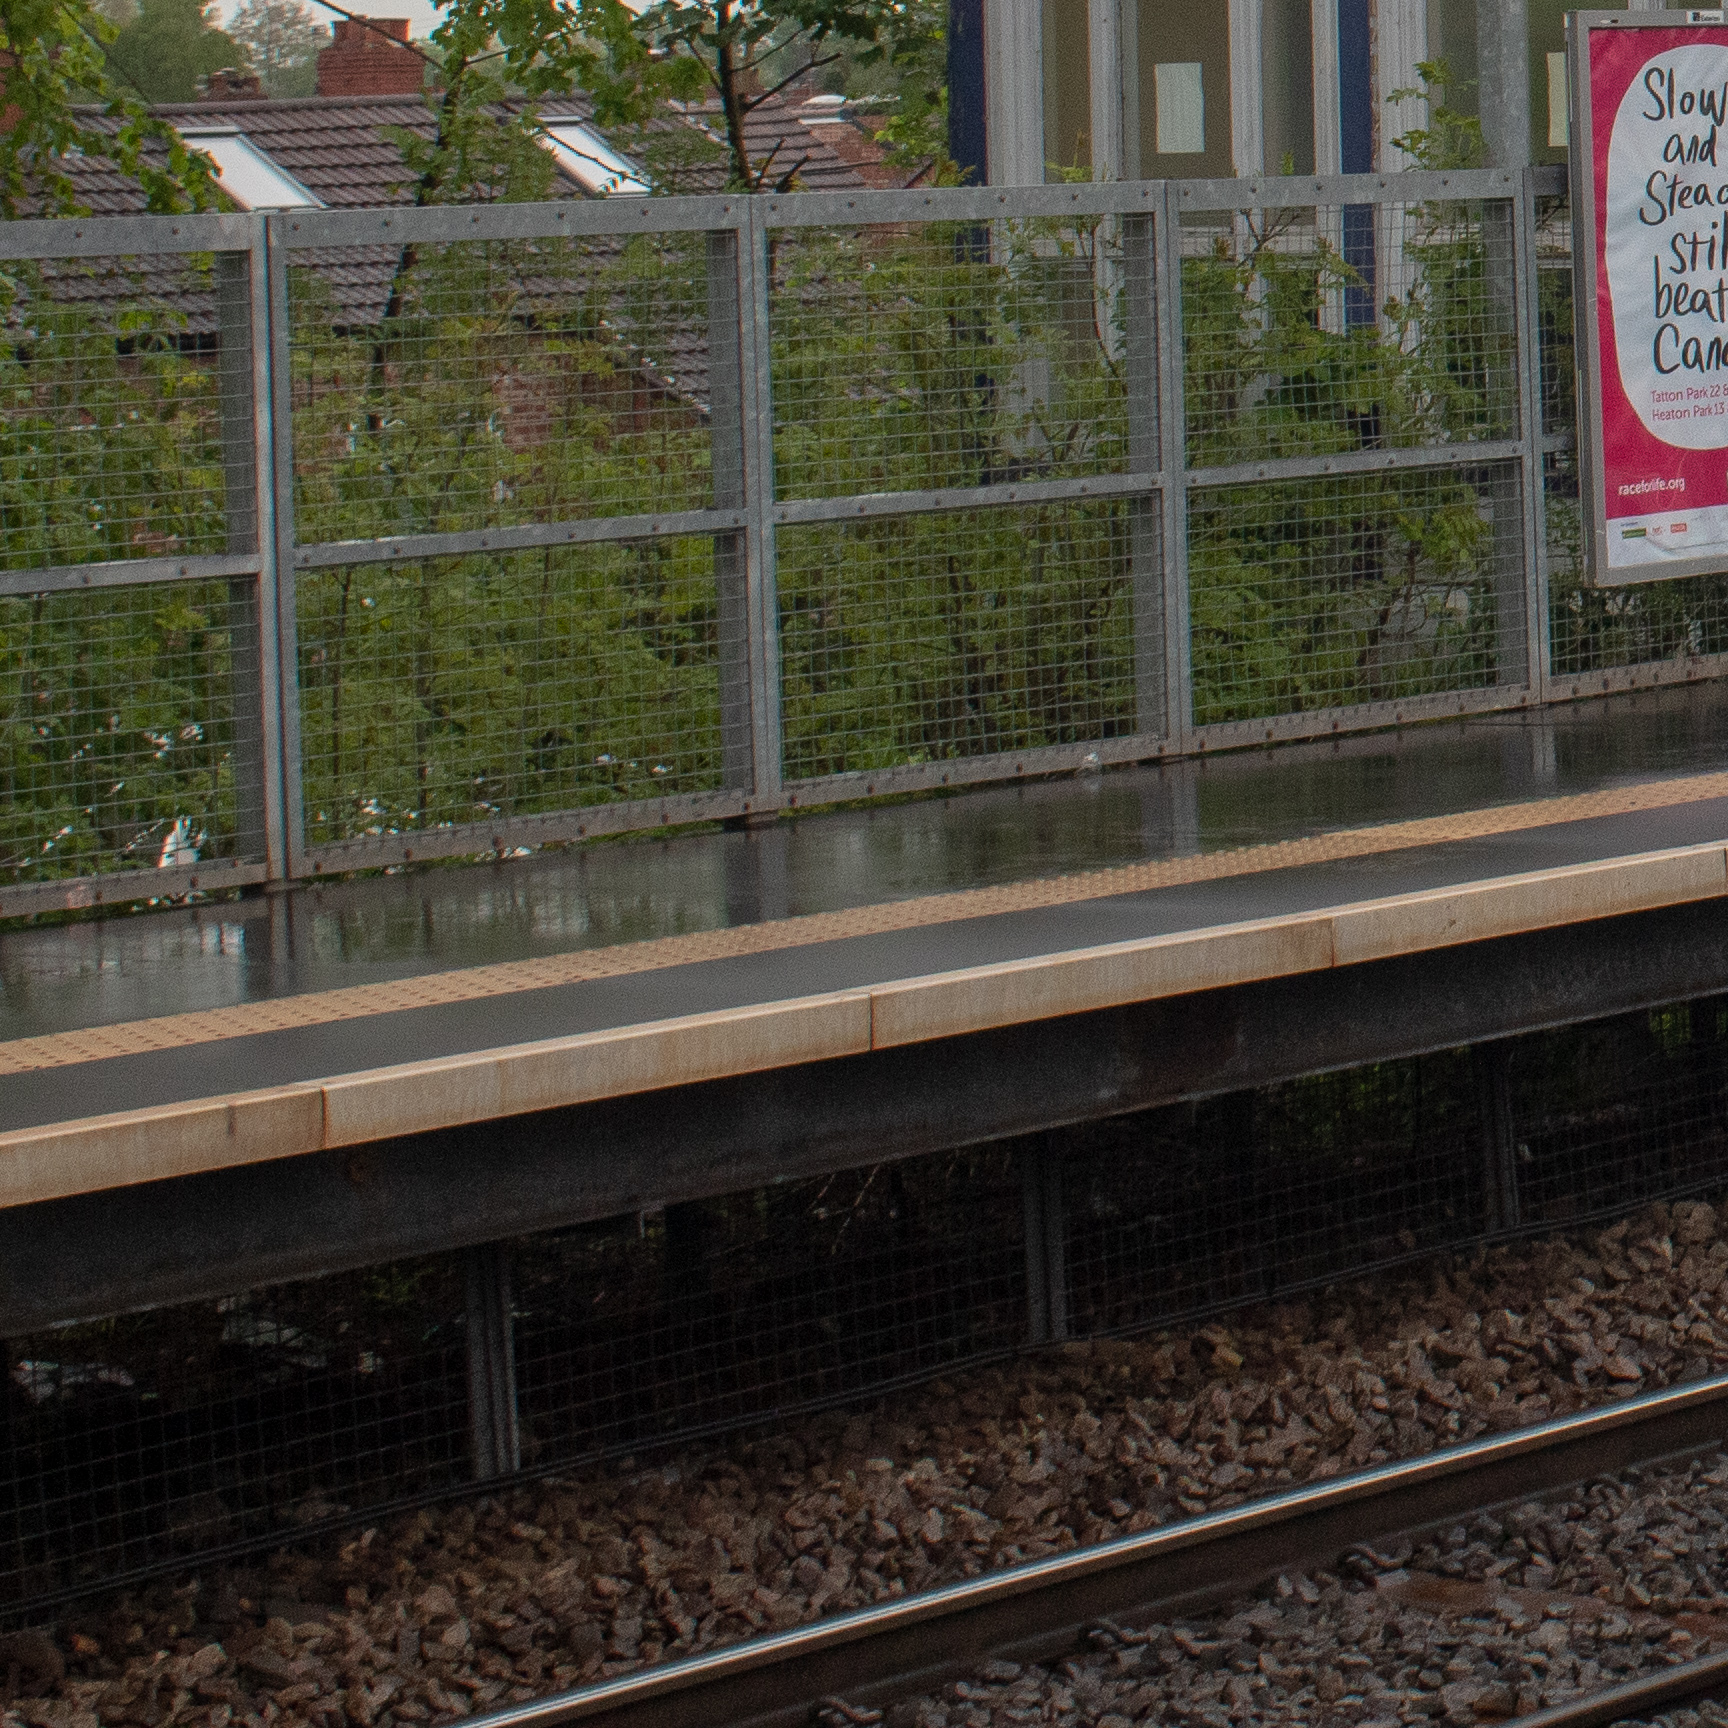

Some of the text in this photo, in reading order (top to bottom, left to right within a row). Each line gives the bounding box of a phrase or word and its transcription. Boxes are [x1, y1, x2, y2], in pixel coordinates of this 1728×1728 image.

[1643, 67, 1728, 126] Slow
[1663, 123, 1717, 168] and
[1651, 389, 1684, 403] Tatton
[1686, 386, 1708, 400] Park
[1709, 384, 1720, 398] 22
[1652, 408, 1690, 421] Heaton
[1693, 404, 1713, 418] Park
[1714, 401, 1724, 415] 13
[1618, 477, 1685, 495] raceforlife.org
